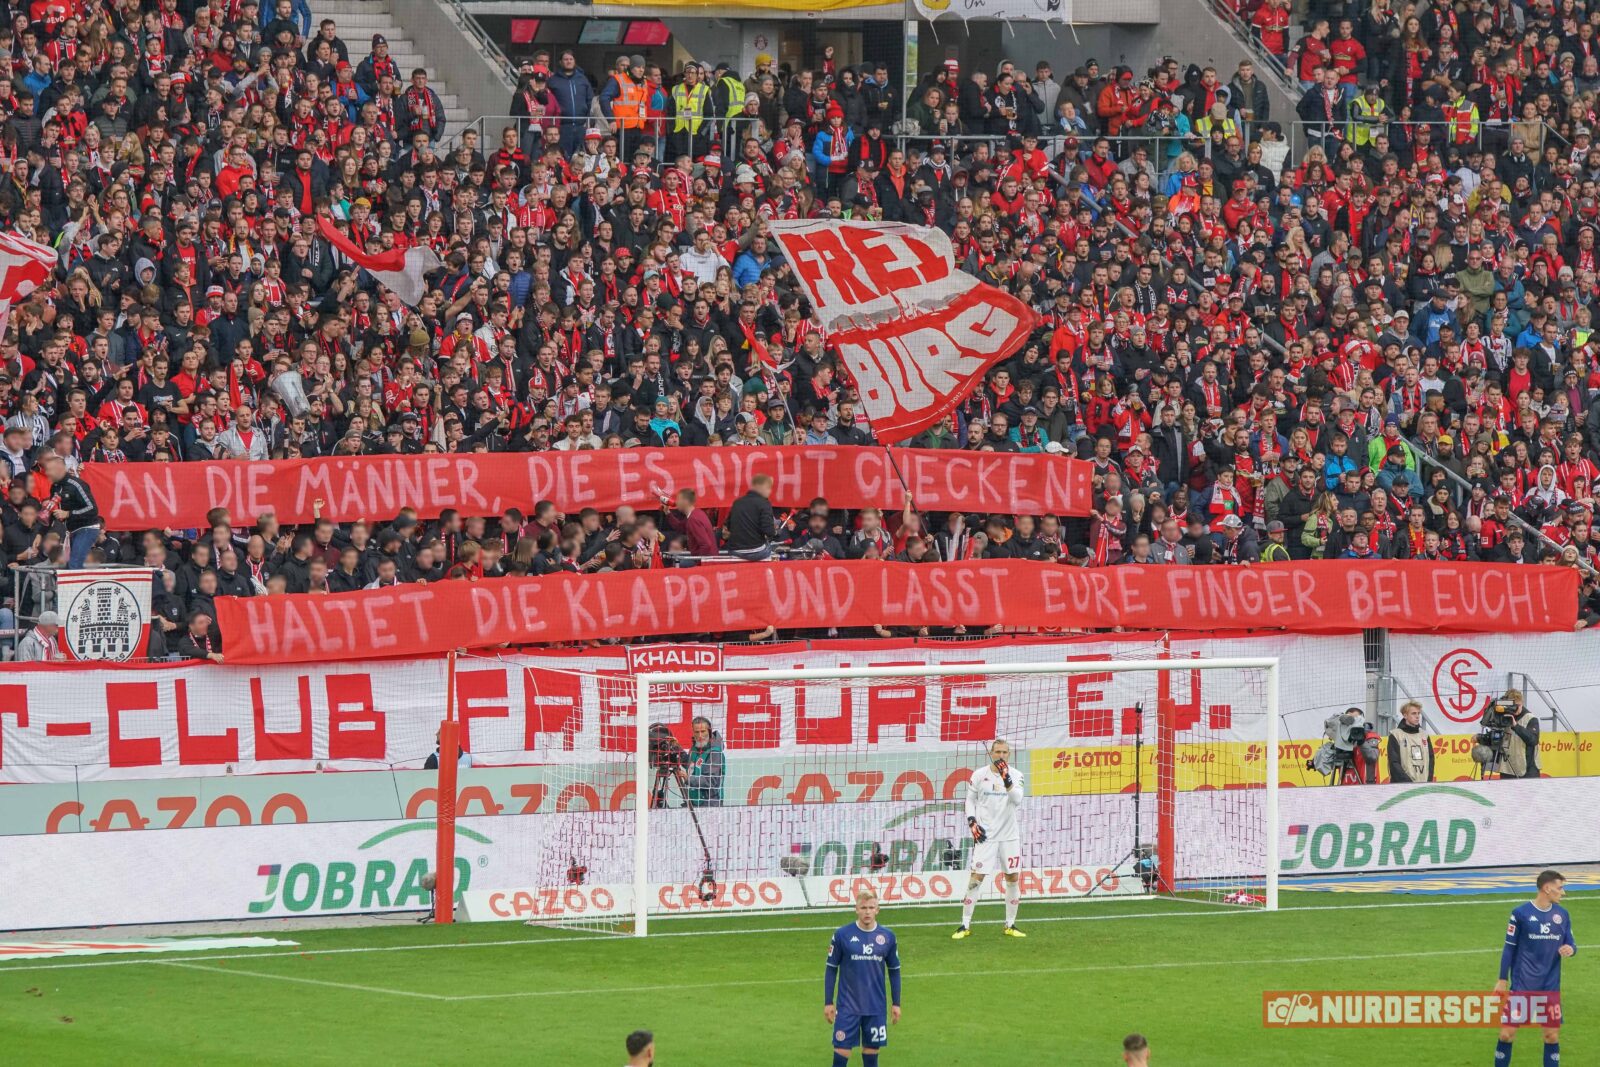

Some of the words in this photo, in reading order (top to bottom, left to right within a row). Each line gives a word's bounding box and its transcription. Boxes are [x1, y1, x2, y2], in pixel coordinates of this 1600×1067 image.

[779, 226, 949, 308] FREI
[839, 301, 1019, 420] BURG
[110, 468, 178, 518] AN
[206, 463, 276, 519] DIE
[296, 459, 500, 514] MÄNNER,
[528, 450, 597, 501] DIE
[618, 450, 675, 498] ES
[692, 448, 838, 500] NICHT
[855, 449, 1087, 511] CHECKEN:
[248, 591, 436, 653] HALTET
[470, 581, 547, 638] DIE
[563, 569, 746, 635] KLAPPE
[766, 565, 856, 617] UND
[881, 566, 1010, 614] LASST
[1040, 567, 1148, 618] EURE
[1167, 567, 1324, 619] FINGER
[1347, 568, 1411, 621] BEI
[1431, 567, 1551, 625] EUCH!
[633, 650, 716, 668] KHALID
[672, 681, 705, 694] UNS
[1074, 751, 1122, 768] LOTTO
[1344, 772, 1357, 783] TV
[1412, 764, 1425, 775] TV
[248, 856, 472, 914] JOBRAD
[1281, 818, 1478, 872] JOBRAD
[1008, 856, 1020, 869] 27
[489, 886, 615, 918] CAZOO
[659, 880, 783, 911] CAZOO
[829, 874, 953, 902] CAZOO
[1549, 1004, 1562, 1021] 19
[870, 1025, 887, 1042] 29
